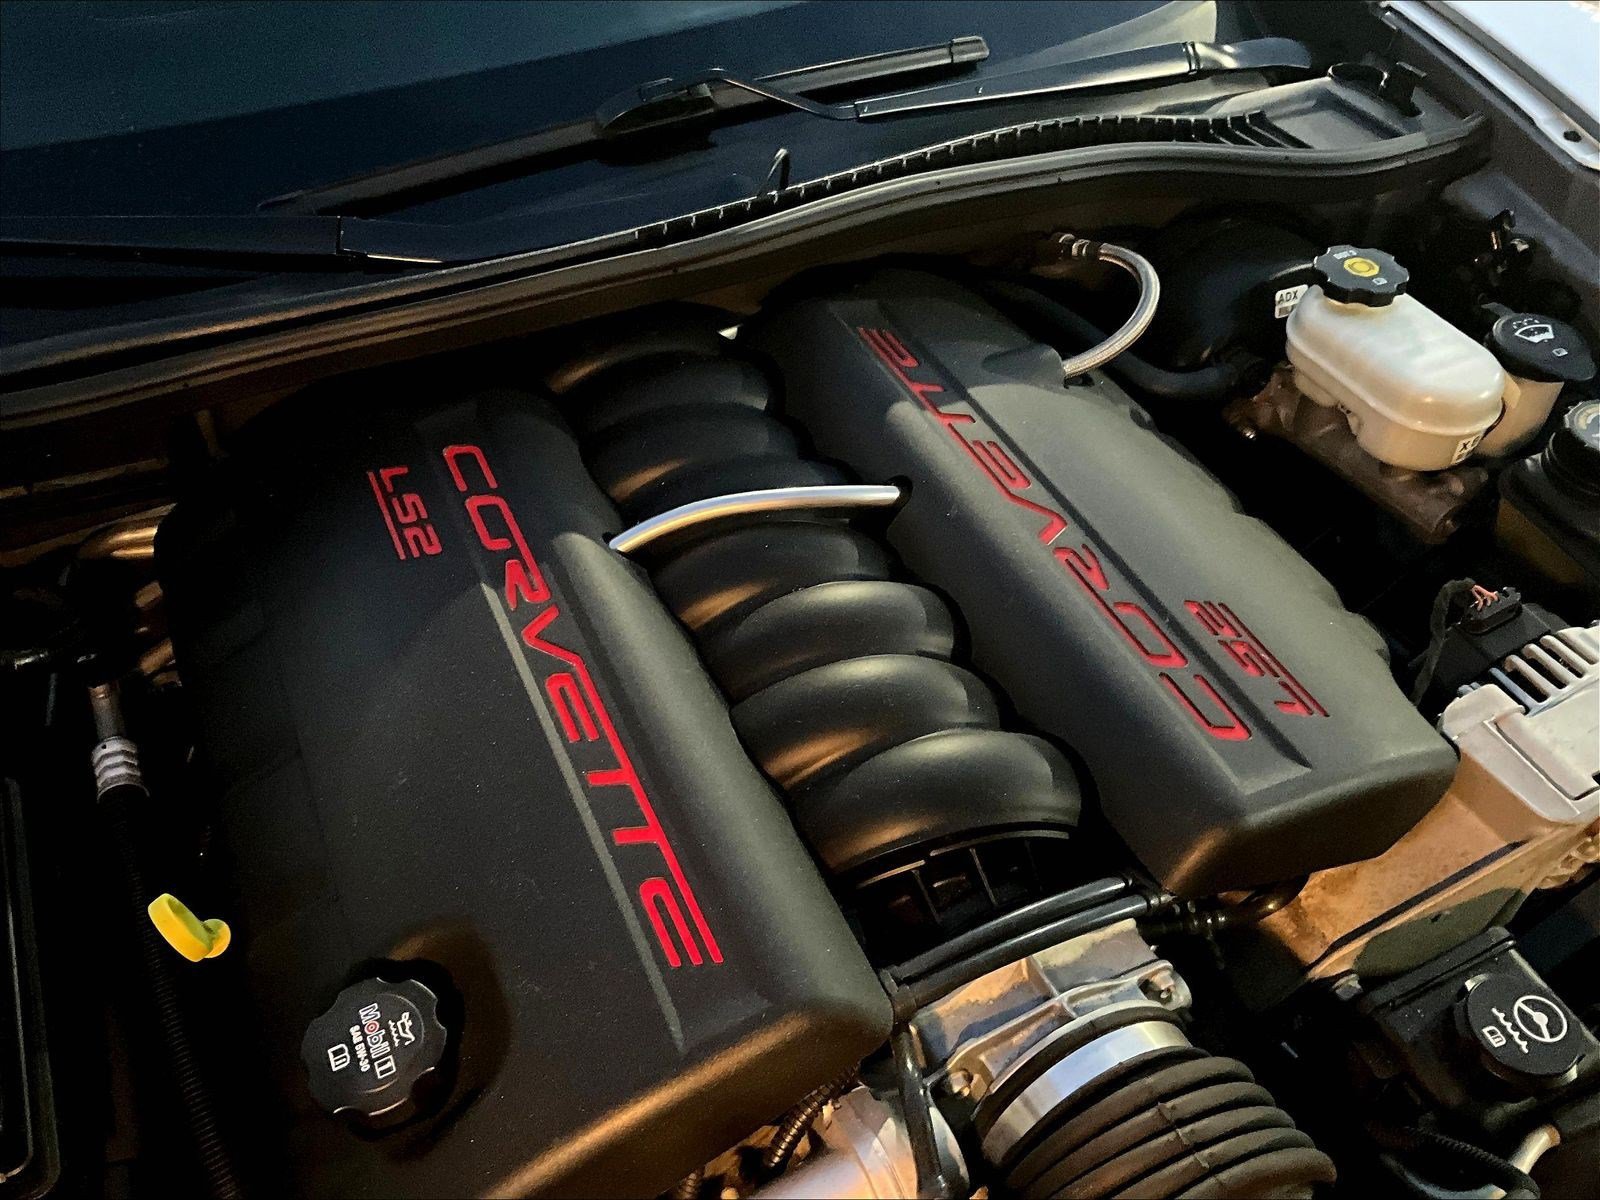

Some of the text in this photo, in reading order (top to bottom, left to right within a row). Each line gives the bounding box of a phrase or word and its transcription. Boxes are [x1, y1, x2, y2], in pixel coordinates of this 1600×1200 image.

[1278, 290, 1299, 304] ADX
[378, 466, 442, 558] LS2
[857, 327, 1252, 740] CORVETTE
[1184, 600, 1315, 717] LS2
[443, 444, 724, 969] CORVETTE
[349, 1025, 370, 1072] SAE 5W-30
[359, 1003, 391, 1058] Mobil
